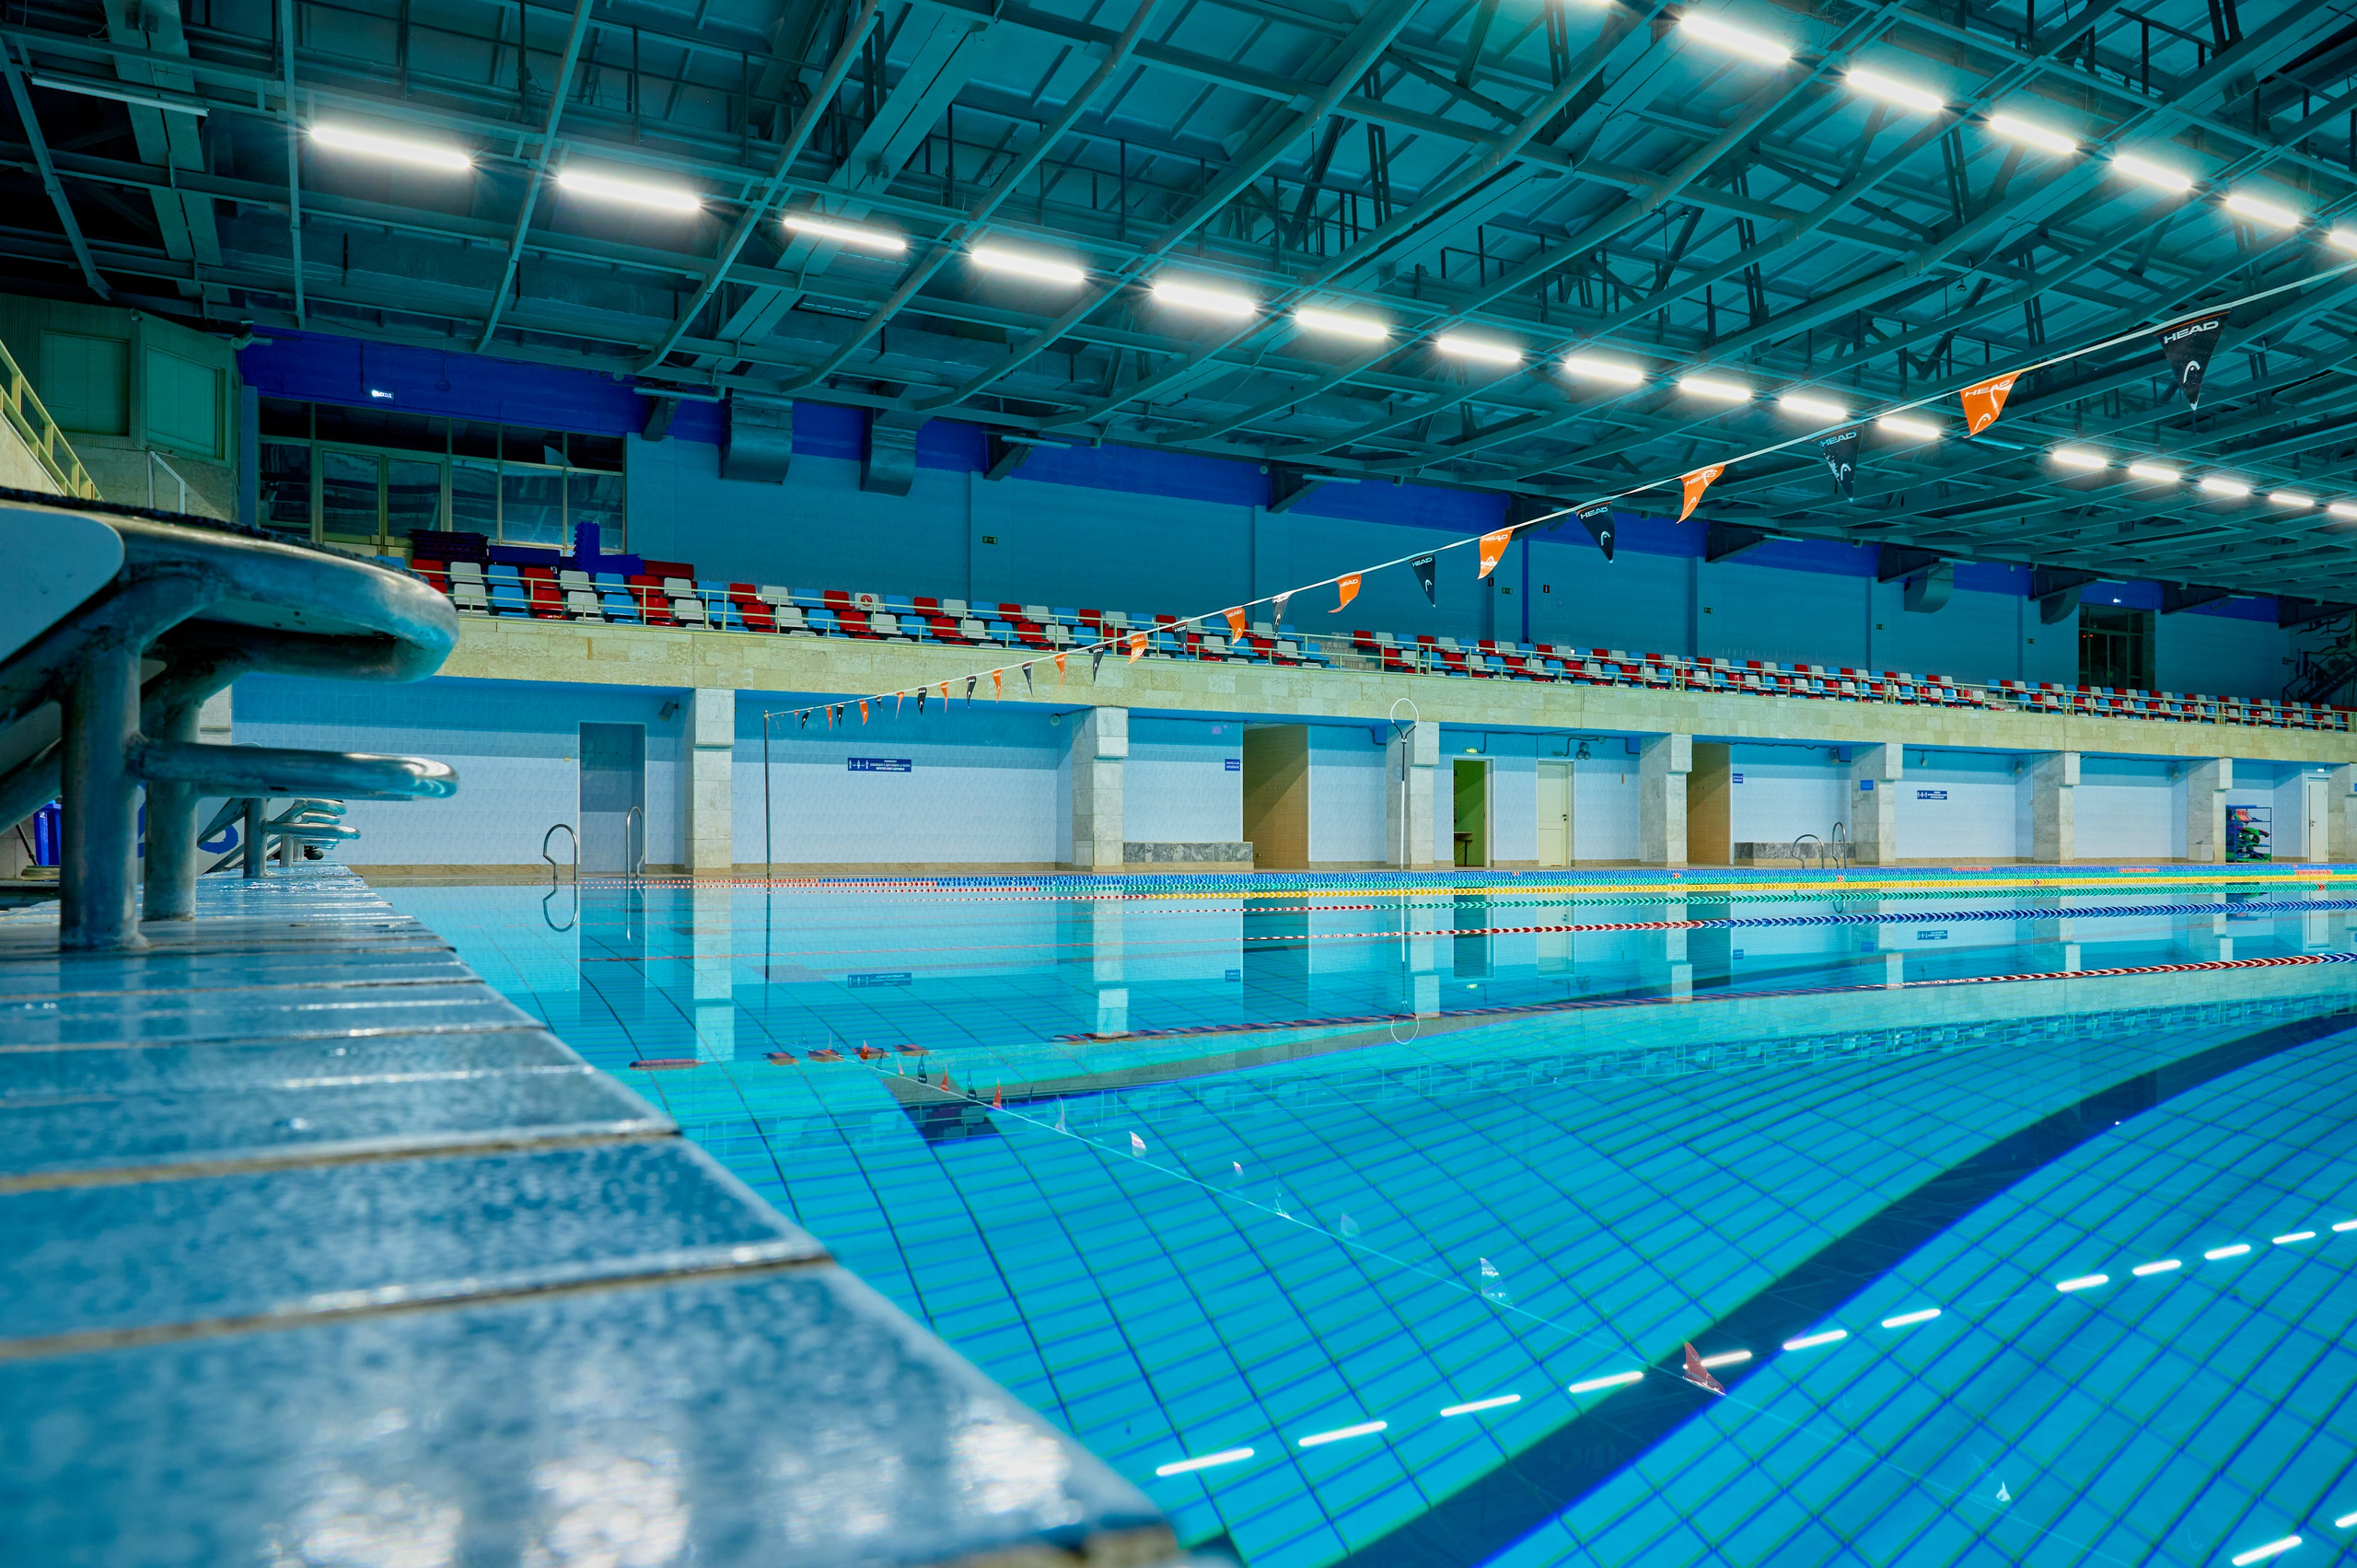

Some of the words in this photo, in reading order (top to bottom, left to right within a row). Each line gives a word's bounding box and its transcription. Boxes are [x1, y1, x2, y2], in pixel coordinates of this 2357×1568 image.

[2164, 320, 2219, 344] HEAD
[1964, 378, 2012, 398] HEAD
[1819, 431, 1857, 447] HEAD
[1580, 506, 1608, 519] HEAD
[1411, 557, 1433, 566] HEAD
[1340, 579, 1358, 587] HEAD
